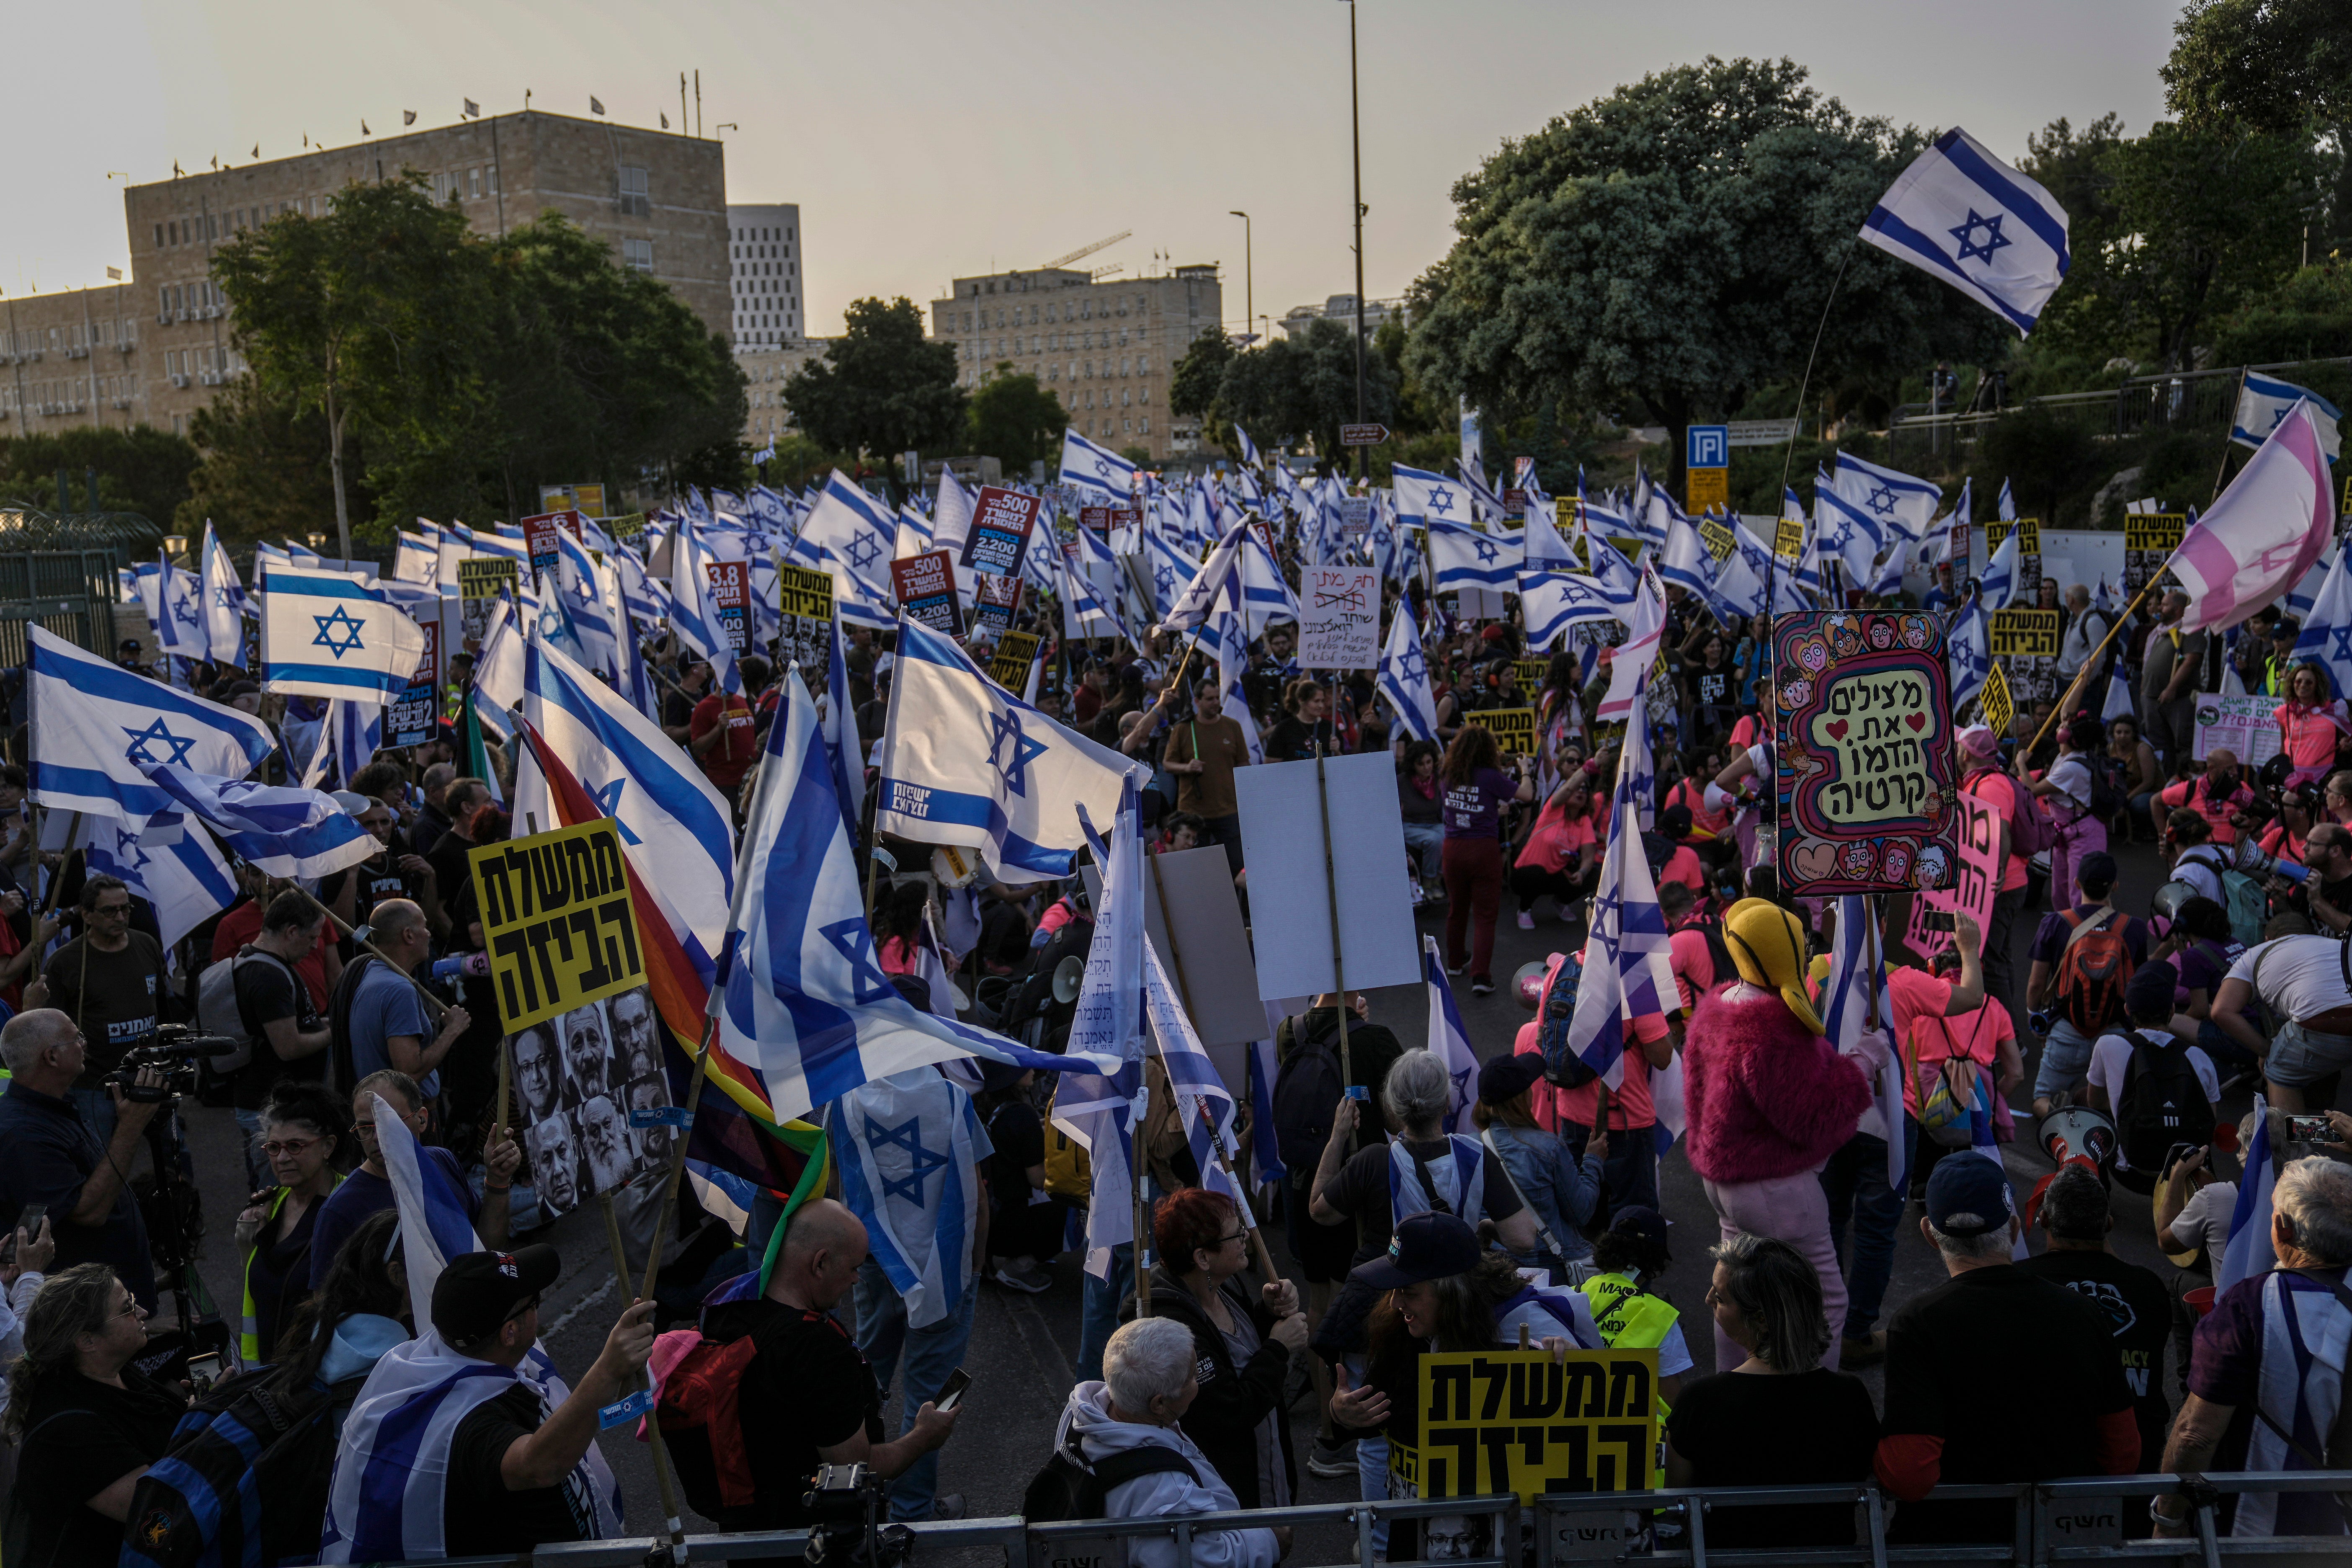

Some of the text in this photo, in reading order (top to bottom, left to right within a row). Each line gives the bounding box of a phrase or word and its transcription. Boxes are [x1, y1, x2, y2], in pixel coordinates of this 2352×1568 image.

[1702, 438, 1716, 463] P
[1001, 494, 1031, 514] 500
[551, 514, 568, 529] 6
[981, 515, 1025, 532] המסורת
[985, 506, 1027, 524] למשרד
[2128, 515, 2183, 529] ממשלת
[978, 528, 1020, 544] במקום
[1988, 522, 2037, 537] ממלת
[2128, 532, 2182, 547] הביזה
[976, 536, 1017, 555] 2,200
[462, 560, 516, 576] ממשלת
[914, 555, 942, 575] 500
[709, 565, 740, 587] 3.8
[783, 567, 831, 594] ממשלת
[903, 571, 945, 588] למשרד
[1346, 574, 1374, 593] חג
[905, 580, 947, 597] המסורת
[783, 586, 831, 618] הביזה
[908, 594, 949, 610] במקום
[911, 603, 951, 621] 2,200
[1340, 613, 1373, 623] שוחד
[1995, 611, 2055, 630] ממשלת
[998, 634, 1034, 660] ממשלת
[1993, 631, 2054, 652] הביזה
[1831, 678, 1922, 715] מצילים
[1990, 667, 2010, 726] ממשלת
[388, 708, 423, 722] חדשים
[423, 699, 433, 727] 2
[1857, 714, 1900, 740] את
[1498, 732, 1533, 754] הבי
[1830, 772, 1925, 815] קרטיה
[478, 831, 625, 928] ממשלת
[493, 897, 642, 1020] הביזה
[108, 1014, 155, 1038] נאמנים
[2122, 1349, 2149, 1367] ACY
[1428, 1358, 1650, 1421] ממשלת
[2125, 1367, 2150, 1397] N
[603, 1404, 621, 1415] חופשי
[1428, 1424, 1648, 1498] הביזה
